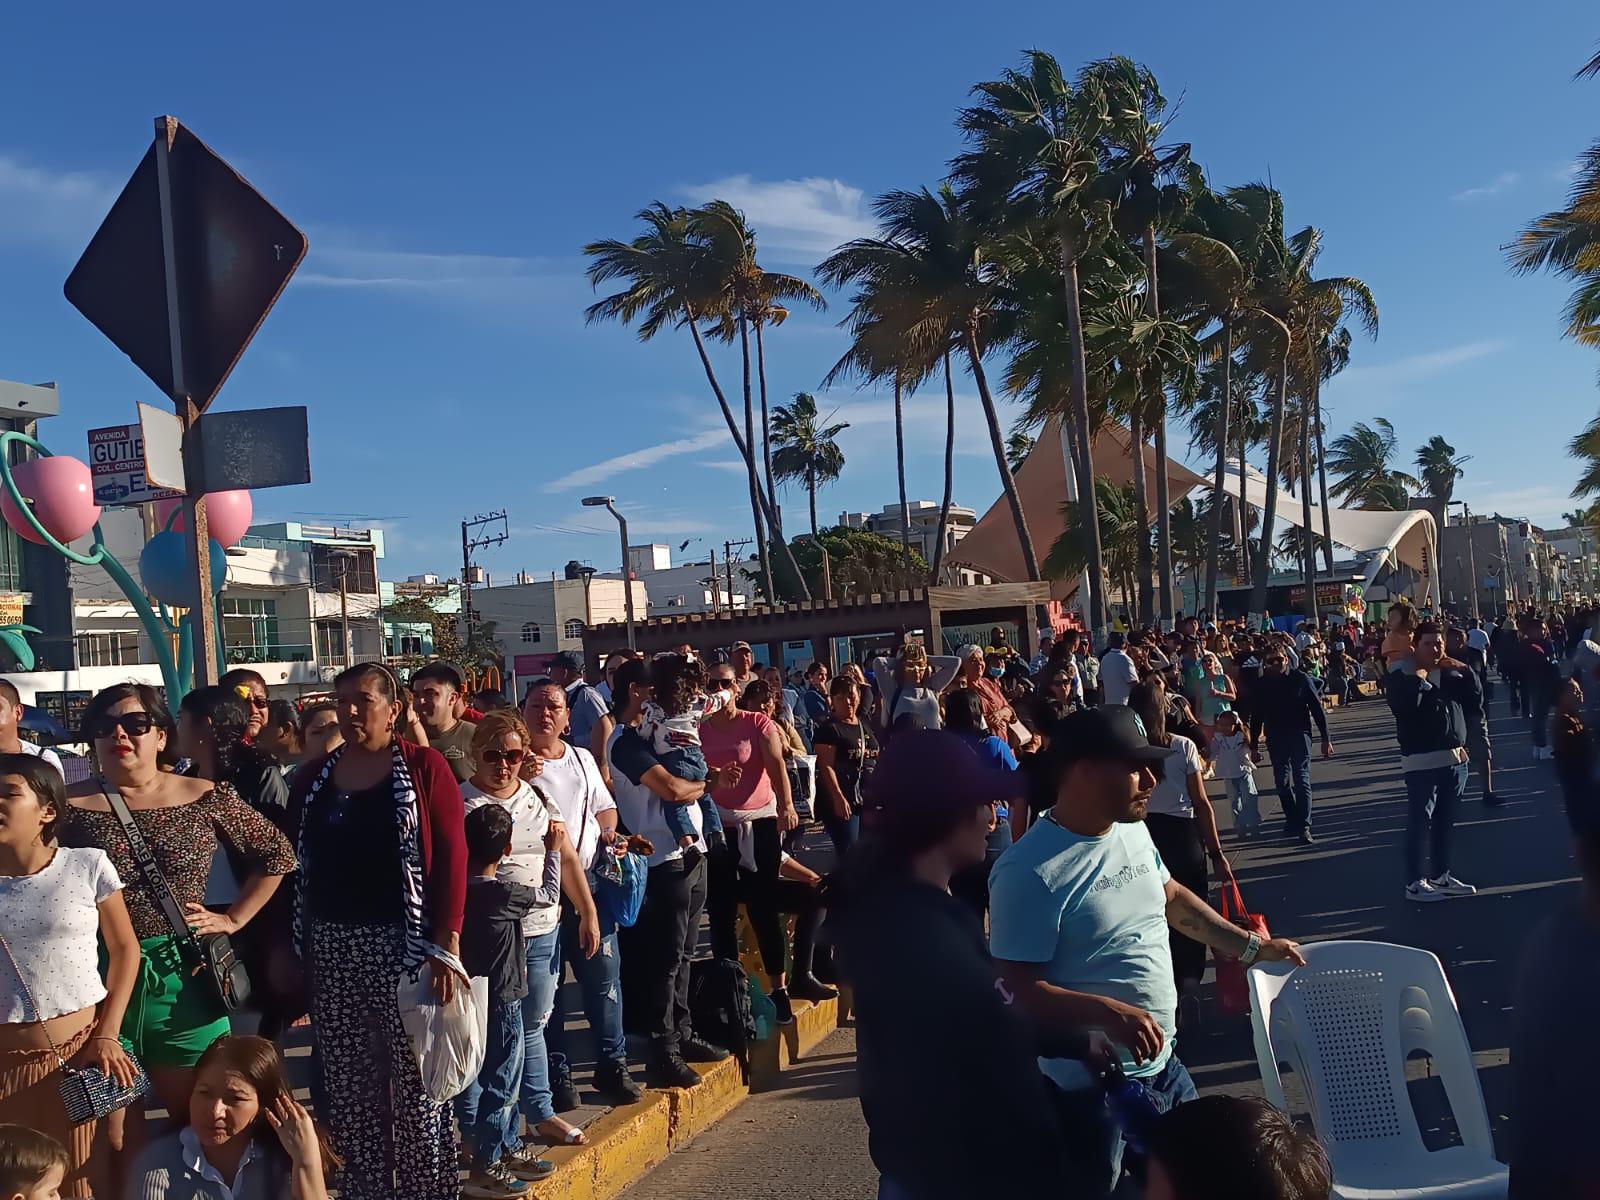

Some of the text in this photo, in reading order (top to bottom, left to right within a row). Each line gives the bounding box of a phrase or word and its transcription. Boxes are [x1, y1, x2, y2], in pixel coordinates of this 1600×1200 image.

[94, 431, 126, 442] AVENIDA
[96, 460, 145, 473] COL. CENTRO
[124, 822, 169, 900] MICHAE KORS
